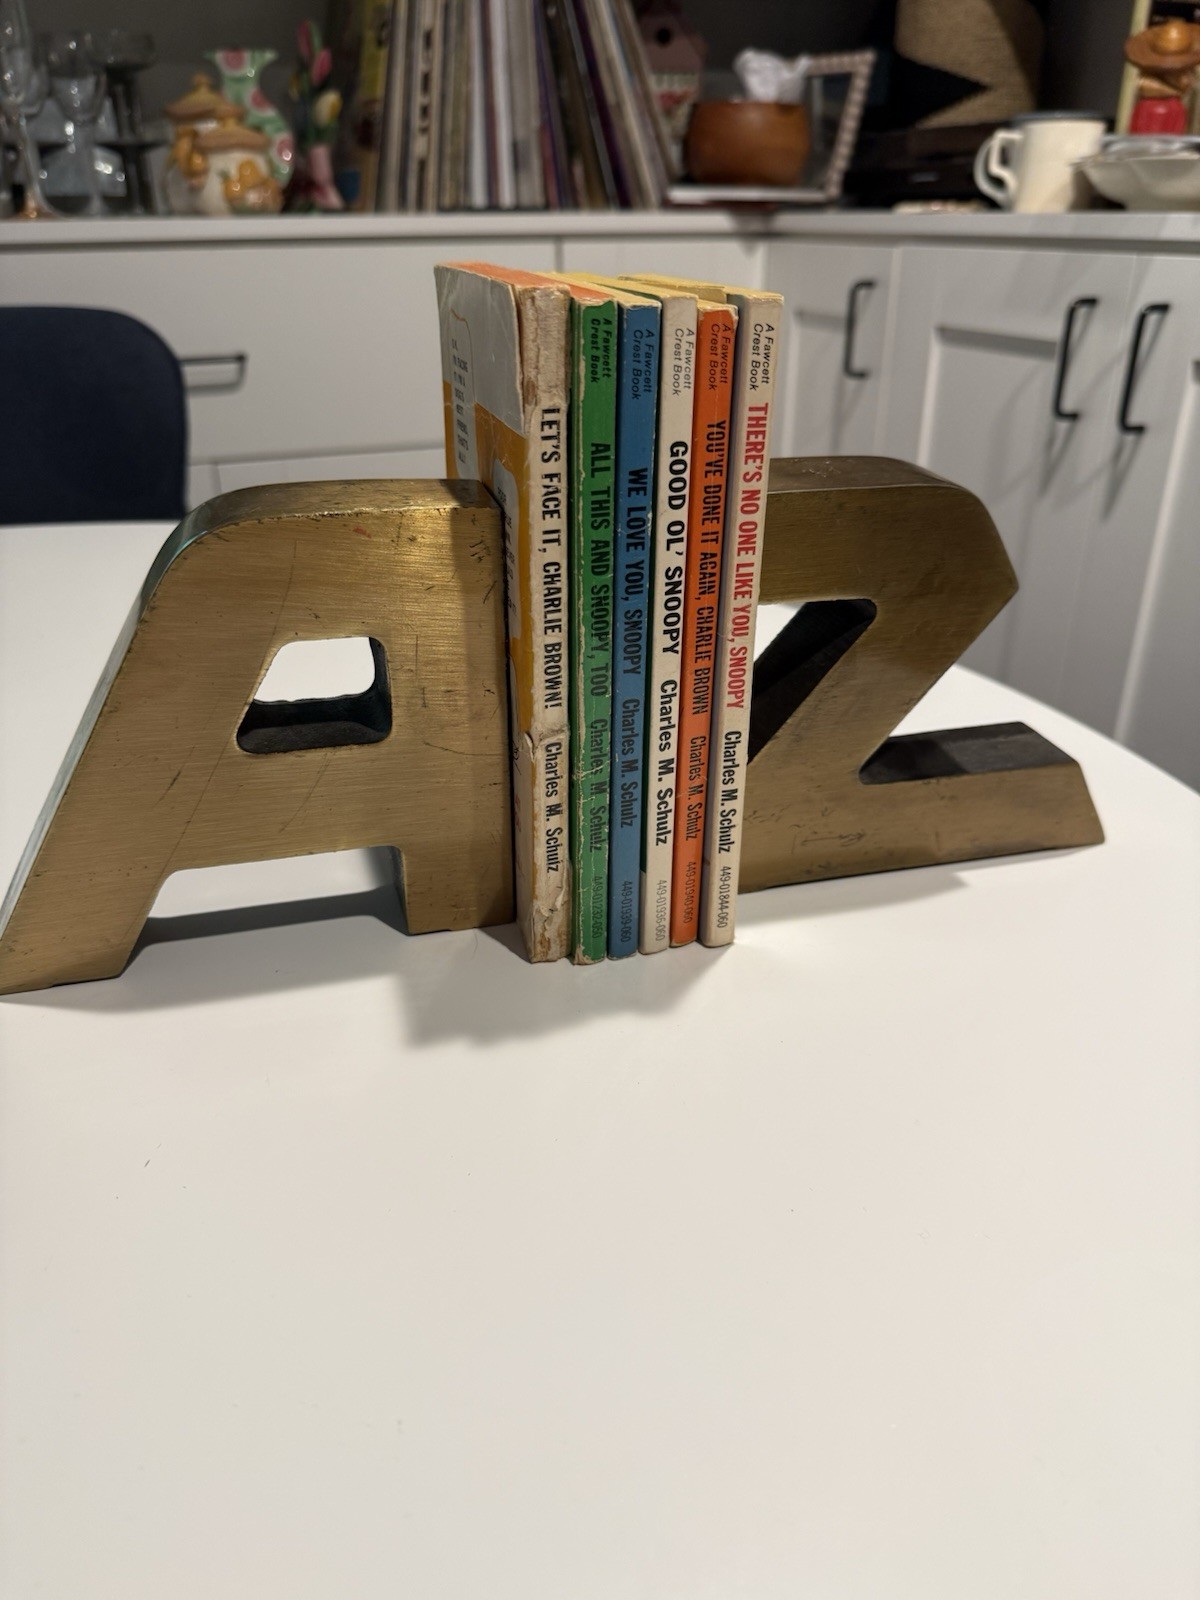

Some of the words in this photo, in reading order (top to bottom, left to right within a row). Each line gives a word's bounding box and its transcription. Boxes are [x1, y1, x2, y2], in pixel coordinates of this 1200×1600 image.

[591, 318, 601, 350] Crest
[632, 329, 644, 364] Crest
[645, 329, 655, 338] A
[674, 328, 684, 361] Crest
[686, 327, 695, 337] A
[710, 323, 720, 356] Crest
[722, 324, 731, 332] A
[752, 323, 764, 356] Crest
[766, 323, 774, 332] A
[590, 355, 600, 383] Book
[602, 330, 612, 378] Fawcett
[643, 343, 654, 393] Fawcett
[683, 340, 694, 390] Fawcett
[708, 360, 718, 391] Book
[720, 336, 731, 384] Fawcett
[749, 360, 761, 391] Book
[761, 336, 774, 384] Fawcett
[631, 368, 643, 400] Book
[672, 364, 683, 396] Book
[540, 407, 561, 464] LET'S
[704, 419, 727, 479] YOU'VE
[743, 402, 768, 483] THERE'S
[590, 442, 611, 479] ALL
[627, 467, 648, 497] WE
[668, 440, 689, 511] GOOD
[541, 472, 561, 521] FACE
[590, 486, 610, 531] THIS
[702, 484, 722, 526] DONE
[741, 489, 761, 519] NO
[537, 528, 561, 553] IT,
[626, 506, 647, 553] LOVE
[666, 521, 685, 556] OL'
[701, 528, 719, 547] IT
[736, 521, 758, 557] ONE
[590, 539, 610, 577] AND
[694, 551, 717, 600] AGAIN,
[542, 561, 562, 635] CHARLIE
[620, 559, 645, 602] YOU,
[733, 563, 754, 601] LIKE
[587, 584, 610, 660] SNOOPY,
[662, 566, 683, 655] SNOOPY
[726, 604, 751, 643] YOU,
[623, 609, 643, 676] SNOOPY
[694, 606, 714, 664] CHARLIE
[543, 643, 563, 709] BROWN!
[590, 663, 609, 697] TOO
[692, 669, 711, 715] BROWN
[726, 643, 748, 709] SNOOPY
[621, 698, 640, 756] Charles
[659, 679, 678, 752] Charles
[590, 718, 608, 776] Charles
[620, 758, 639, 778] M.
[689, 735, 707, 781] Charles
[722, 730, 742, 786] Charles
[544, 741, 564, 798] Charles
[657, 757, 675, 782] M.
[546, 802, 564, 823] M.
[620, 781, 638, 829] Schulz
[688, 784, 704, 800] M.
[720, 788, 739, 806] M.
[590, 805, 608, 853] Schulz
[655, 787, 674, 846] Schulz
[685, 803, 702, 841] Schulz
[718, 809, 737, 855] Schulz
[546, 828, 564, 874] Schulz
[717, 866, 732, 929] 449-01844-060
